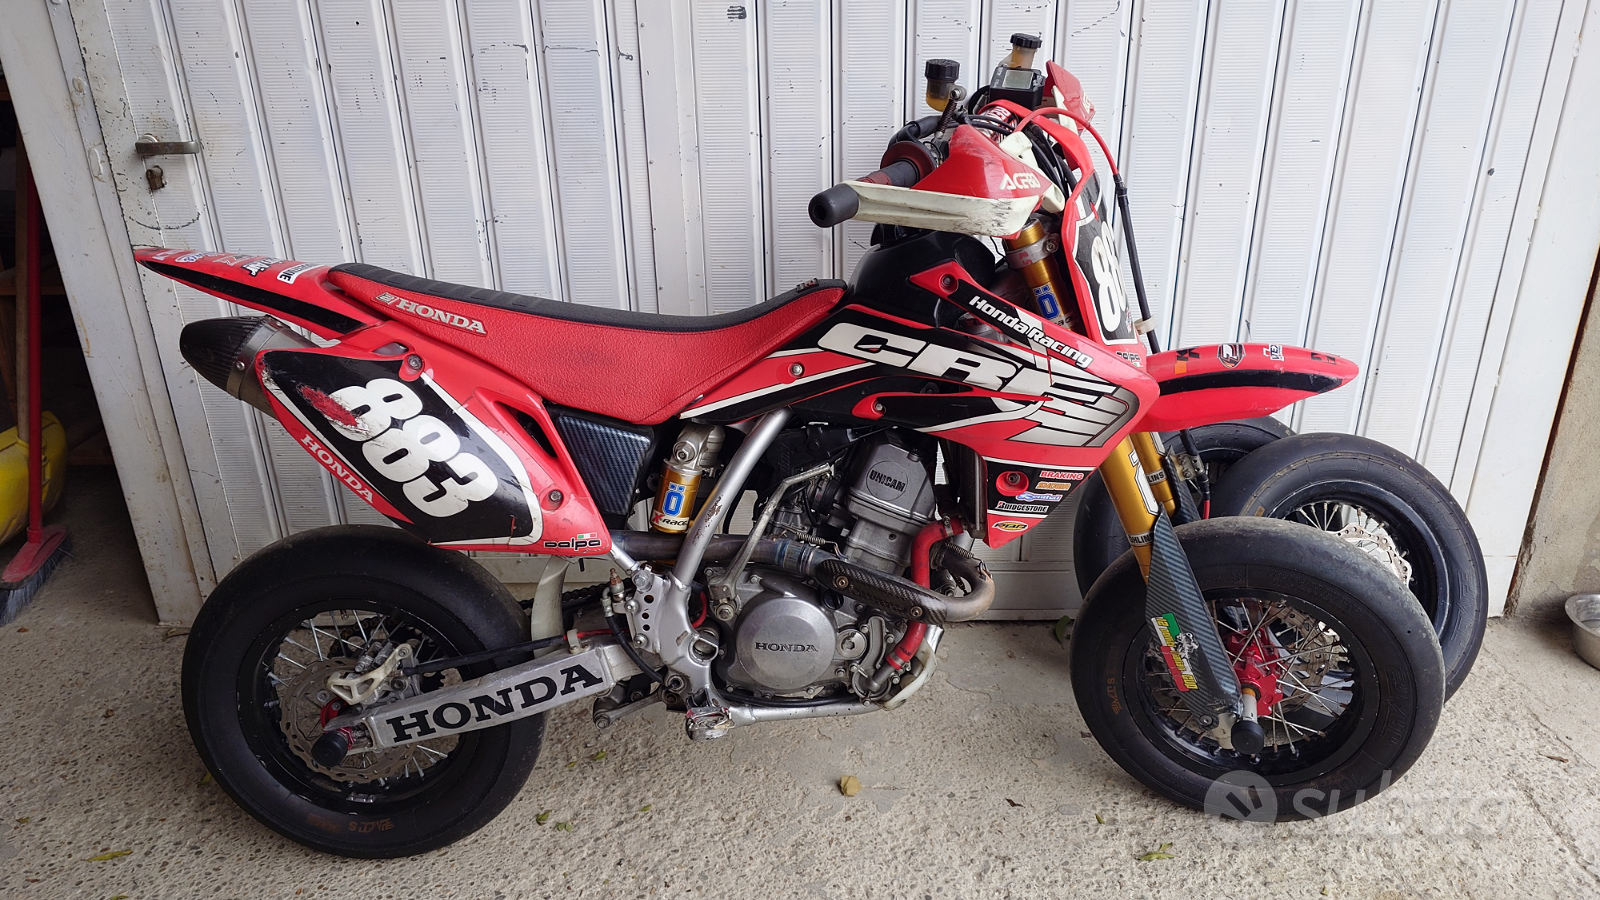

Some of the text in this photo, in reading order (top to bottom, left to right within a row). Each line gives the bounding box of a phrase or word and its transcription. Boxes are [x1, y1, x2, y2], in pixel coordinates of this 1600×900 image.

[395, 298, 487, 335] HONDA
[968, 294, 1094, 369] Honda Racing
[329, 378, 499, 518] 883
[301, 433, 374, 505] HONDA
[868, 468, 906, 493] UNICAM
[1039, 470, 1084, 480] BRAKING
[995, 501, 1050, 513] BRIDGESTONE
[754, 640, 819, 653] HONDA
[386, 664, 604, 743] HONDA
